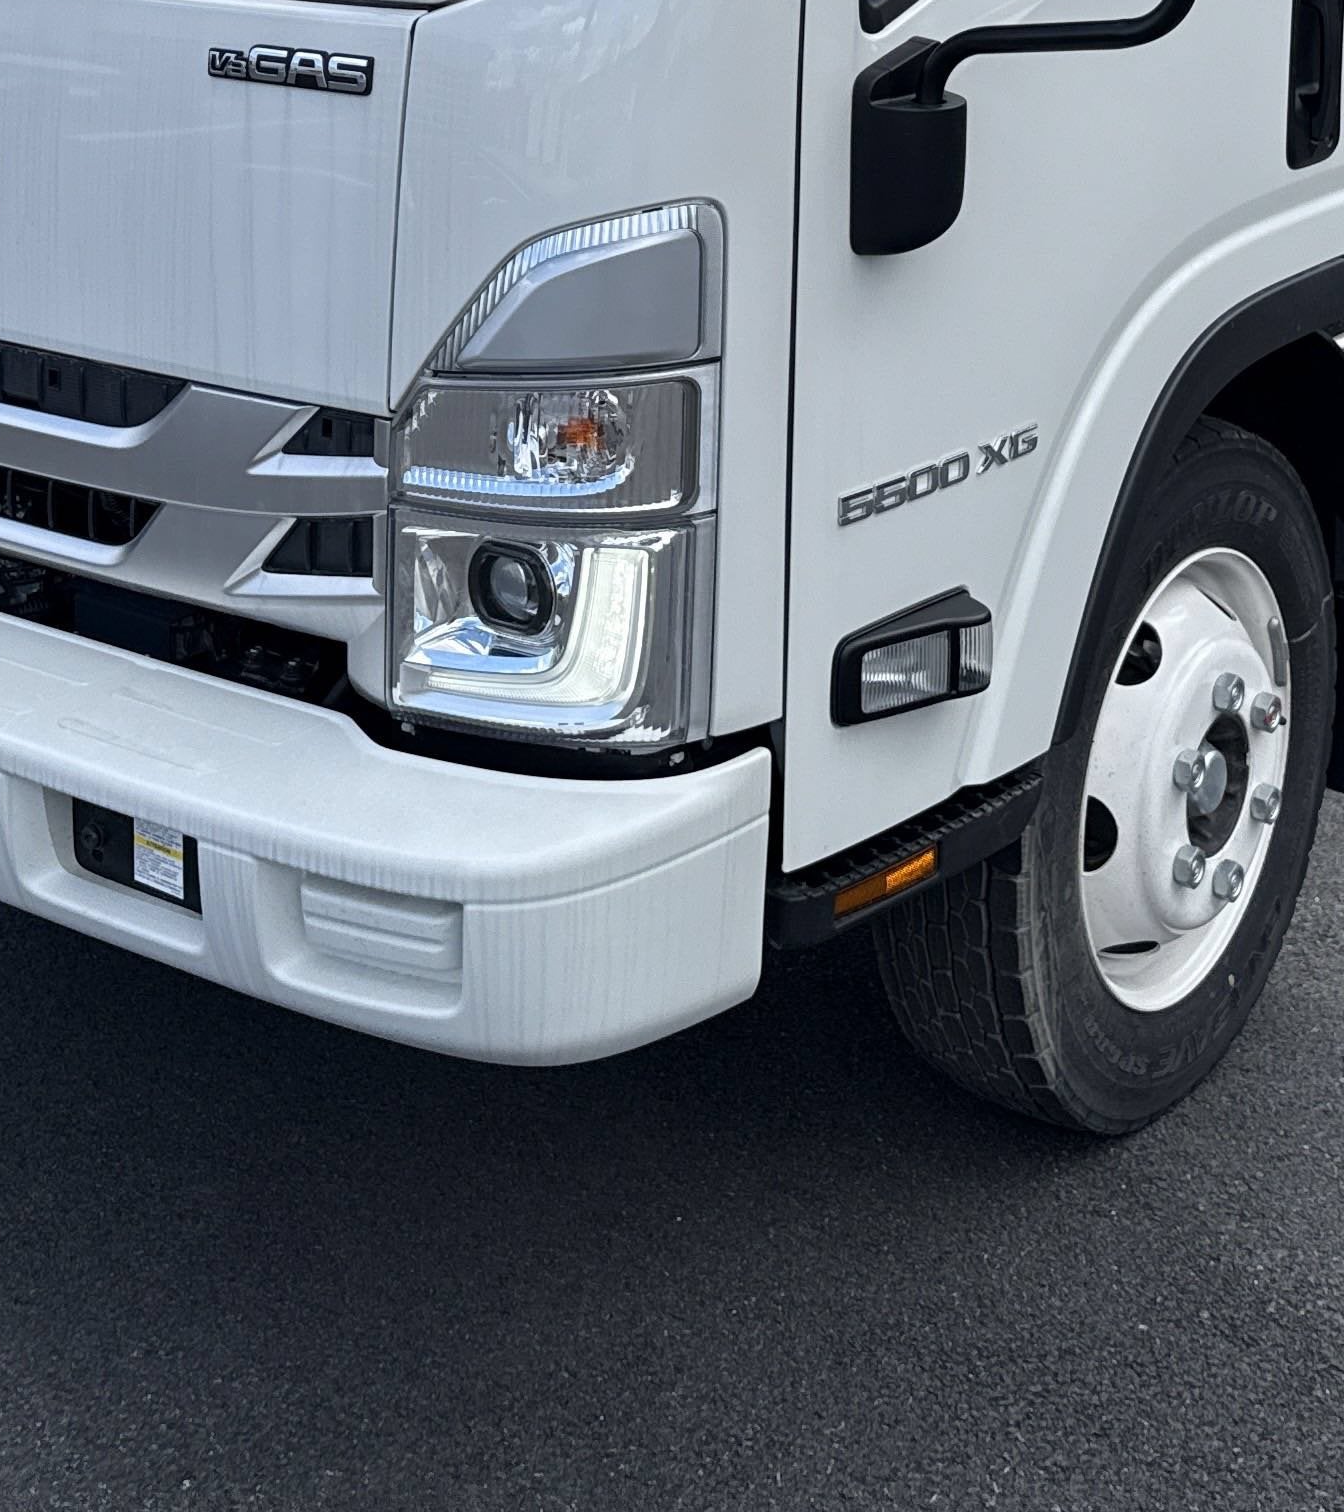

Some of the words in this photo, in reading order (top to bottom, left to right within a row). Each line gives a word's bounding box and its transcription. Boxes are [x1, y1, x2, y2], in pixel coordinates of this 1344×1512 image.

[209, 50, 247, 79] V8
[248, 46, 369, 94] GAS
[633, 179, 703, 214] 2-25
[838, 450, 970, 527] 5500
[975, 421, 1039, 475] XG
